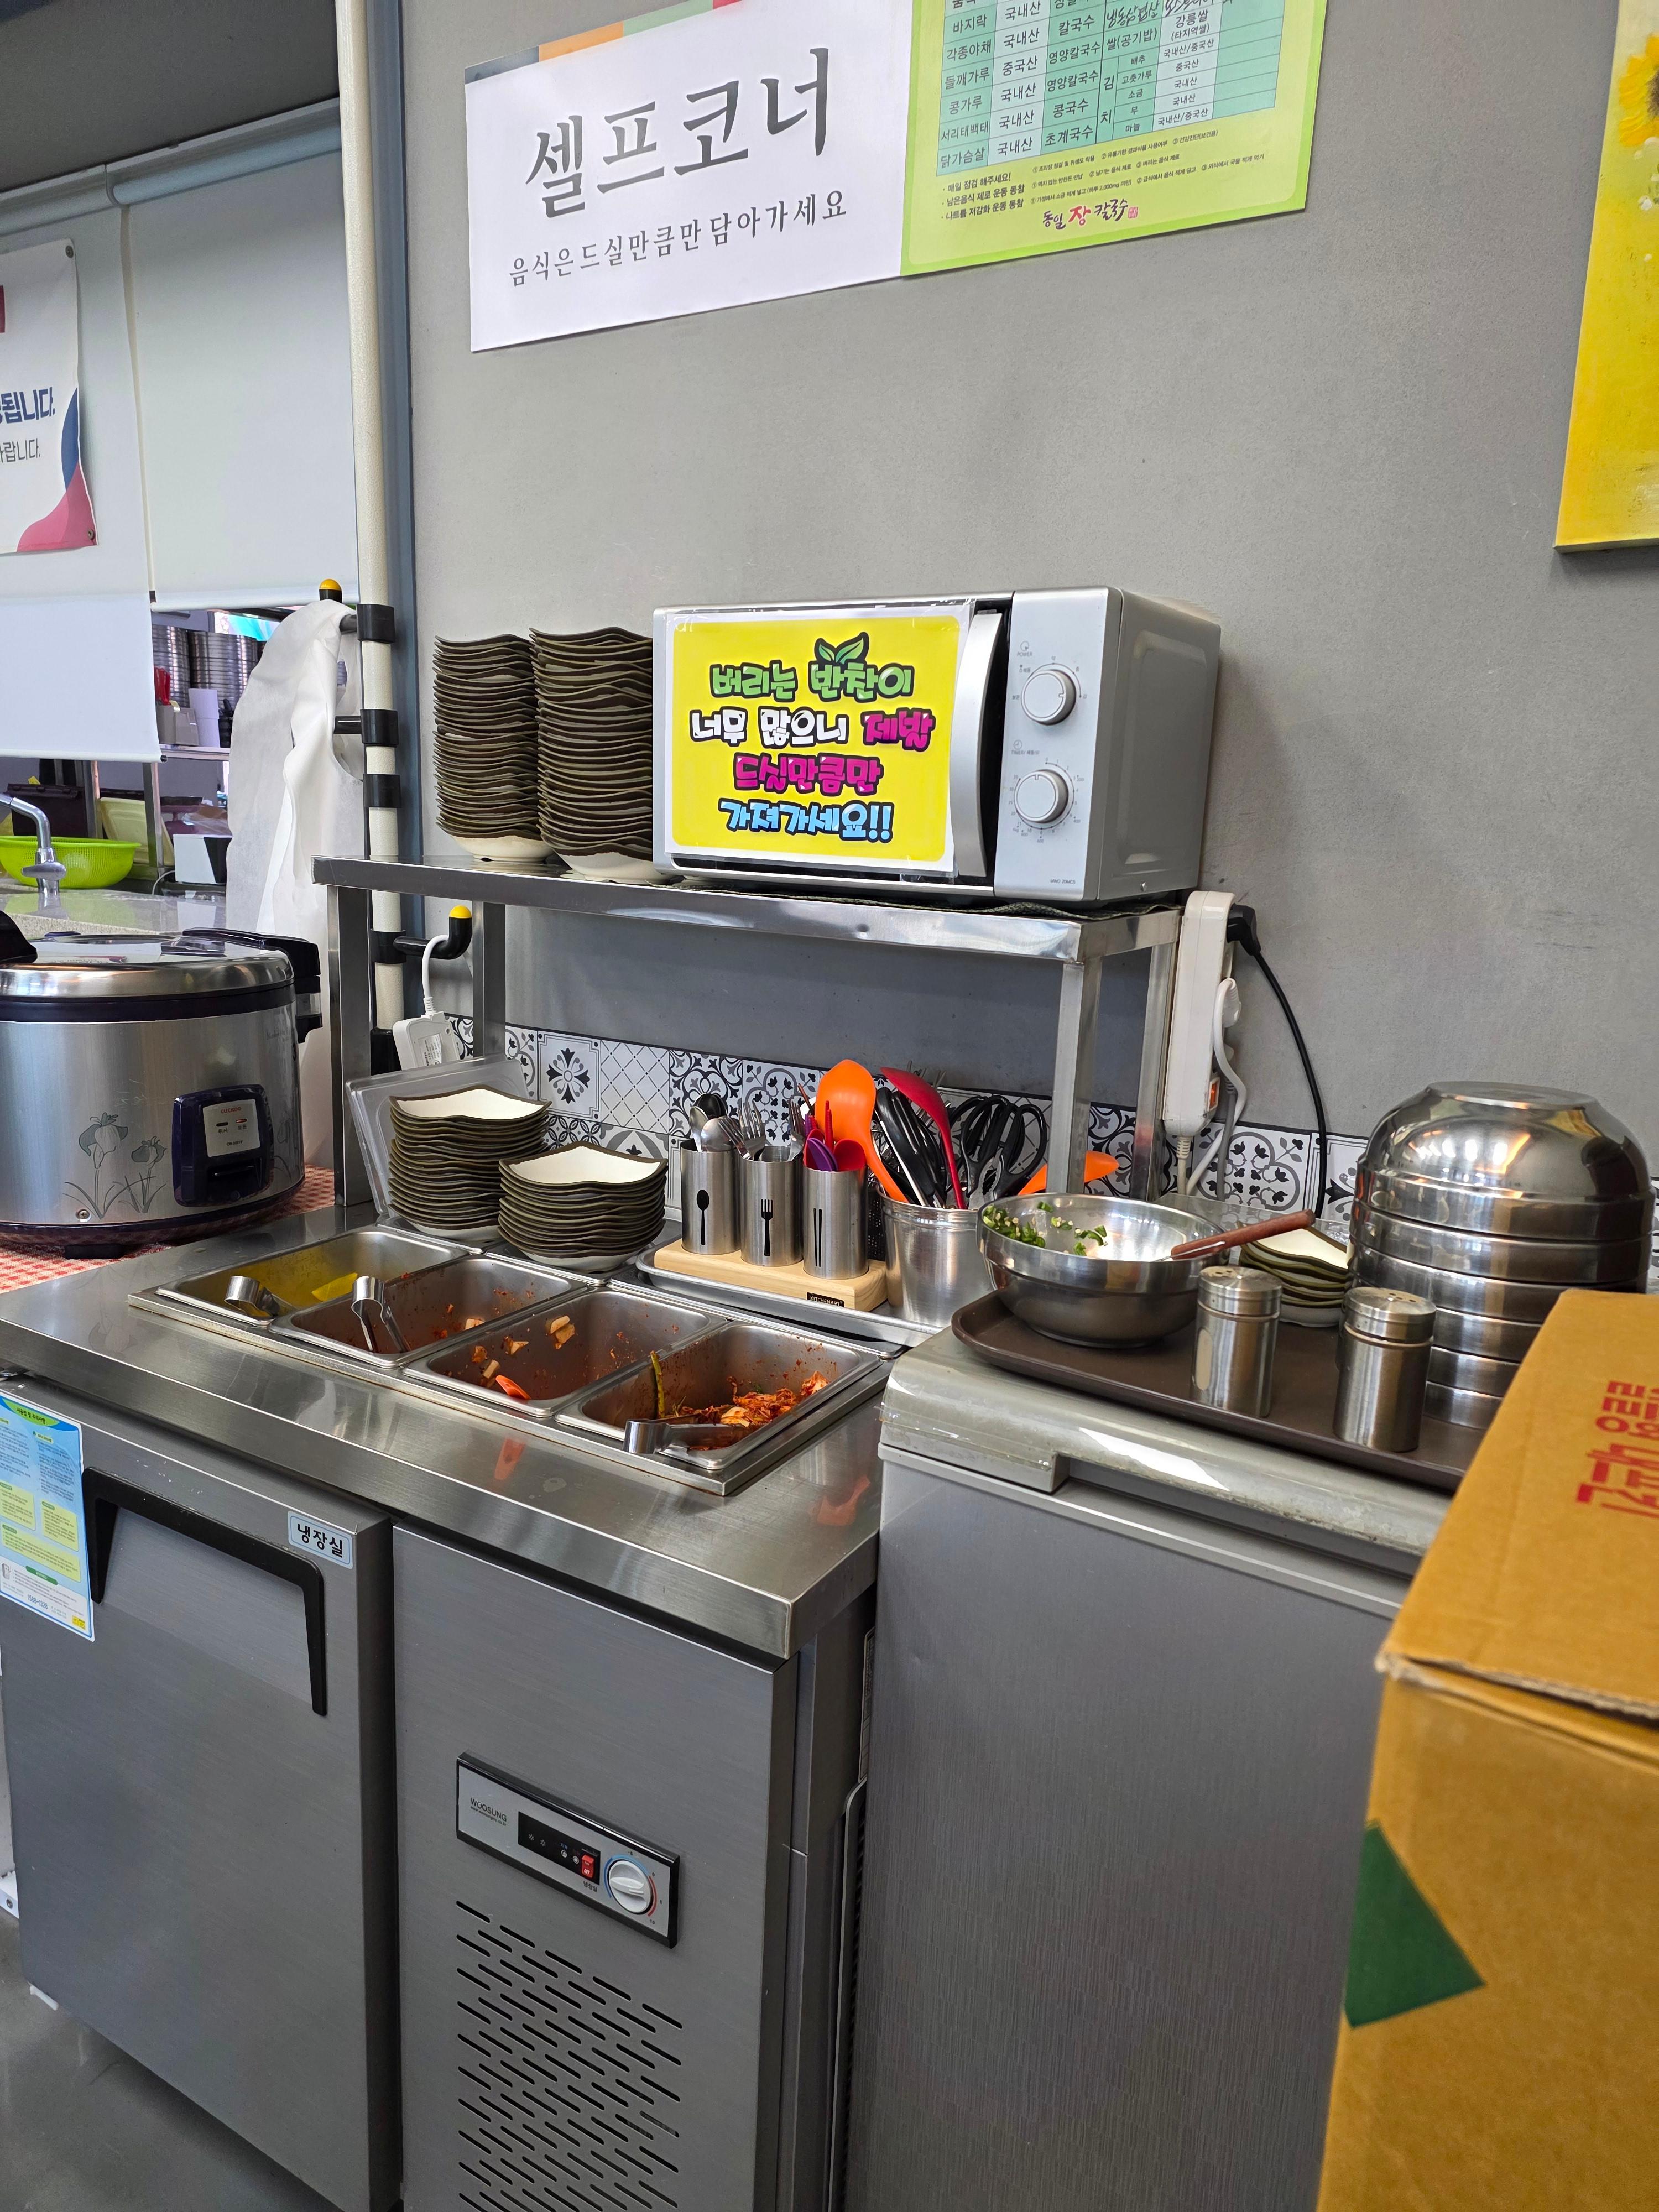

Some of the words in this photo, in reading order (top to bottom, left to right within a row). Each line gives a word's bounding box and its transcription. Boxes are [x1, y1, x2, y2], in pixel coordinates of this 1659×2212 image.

[1005, 1, 1041, 21] 국내산
[1175, 9, 1209, 28] 강릉쌀
[953, 13, 987, 34] 바지락
[1058, 14, 1095, 36] 칼국수
[1171, 23, 1209, 41] (타지역쌀)
[1004, 28, 1040, 48] 국내산
[1107, 27, 1157, 51] 쌀(공기밥)
[1164, 38, 1214, 58] 국내산/중국산
[947, 39, 992, 61] 각종야채
[1049, 41, 1101, 65] 영양칼국수
[1131, 55, 1145, 66] 배추
[1002, 55, 1038, 76] 중국산
[1176, 59, 1199, 72] 중국산
[945, 67, 990, 90] 들깨가루
[1047, 70, 1099, 92] 영양칼국수
[1121, 70, 1152, 84] 고춧가루
[1174, 76, 1197, 88] 국내산
[1000, 83, 1036, 102] 국내산
[1128, 88, 1143, 99] 소금
[1173, 93, 1196, 106] 국내산
[949, 95, 983, 115] 콩가루
[1053, 98, 1089, 118] 콩국수
[1131, 106, 1138, 115] 무
[999, 109, 1034, 129] 국내산
[1126, 123, 1140, 132] 마늘
[1158, 108, 1208, 126] 국내산/중국산
[526, 48, 829, 218] 셀프코너
[941, 121, 988, 141] 서리태백태
[1045, 124, 1093, 147] 초계국수
[941, 146, 985, 168] 닭가슴살
[998, 137, 1032, 156] 국내산
[947, 181, 961, 193] 매일
[964, 179, 977, 190] 점검
[980, 171, 1011, 186] 해주세요!
[947, 192, 974, 207] 남은음식
[977, 190, 991, 201] 제로
[993, 186, 1007, 198] 운동
[1010, 183, 1024, 195] 동참
[946, 208, 967, 221] 나트륨
[969, 204, 990, 216] 저감화
[992, 201, 1006, 212] 운동
[1009, 197, 1023, 209] 동참
[1043, 210, 1066, 230] 동일
[1068, 206, 1091, 226] 장
[1094, 199, 1128, 221] 칼국수
[0, 387, 55, 424] 됩니다.
[710, 660, 798, 702] 버리는
[808, 661, 914, 703] 반찬이
[689, 706, 748, 747] 너무
[758, 706, 849, 749] 많으니
[860, 708, 936, 752] 제발
[733, 752, 884, 796] 드실만큼만
[718, 798, 894, 843] 가져가세요!!
[297, 1522, 343, 1558] 냉장실
[471, 1797, 507, 1822] WOOSUNG
